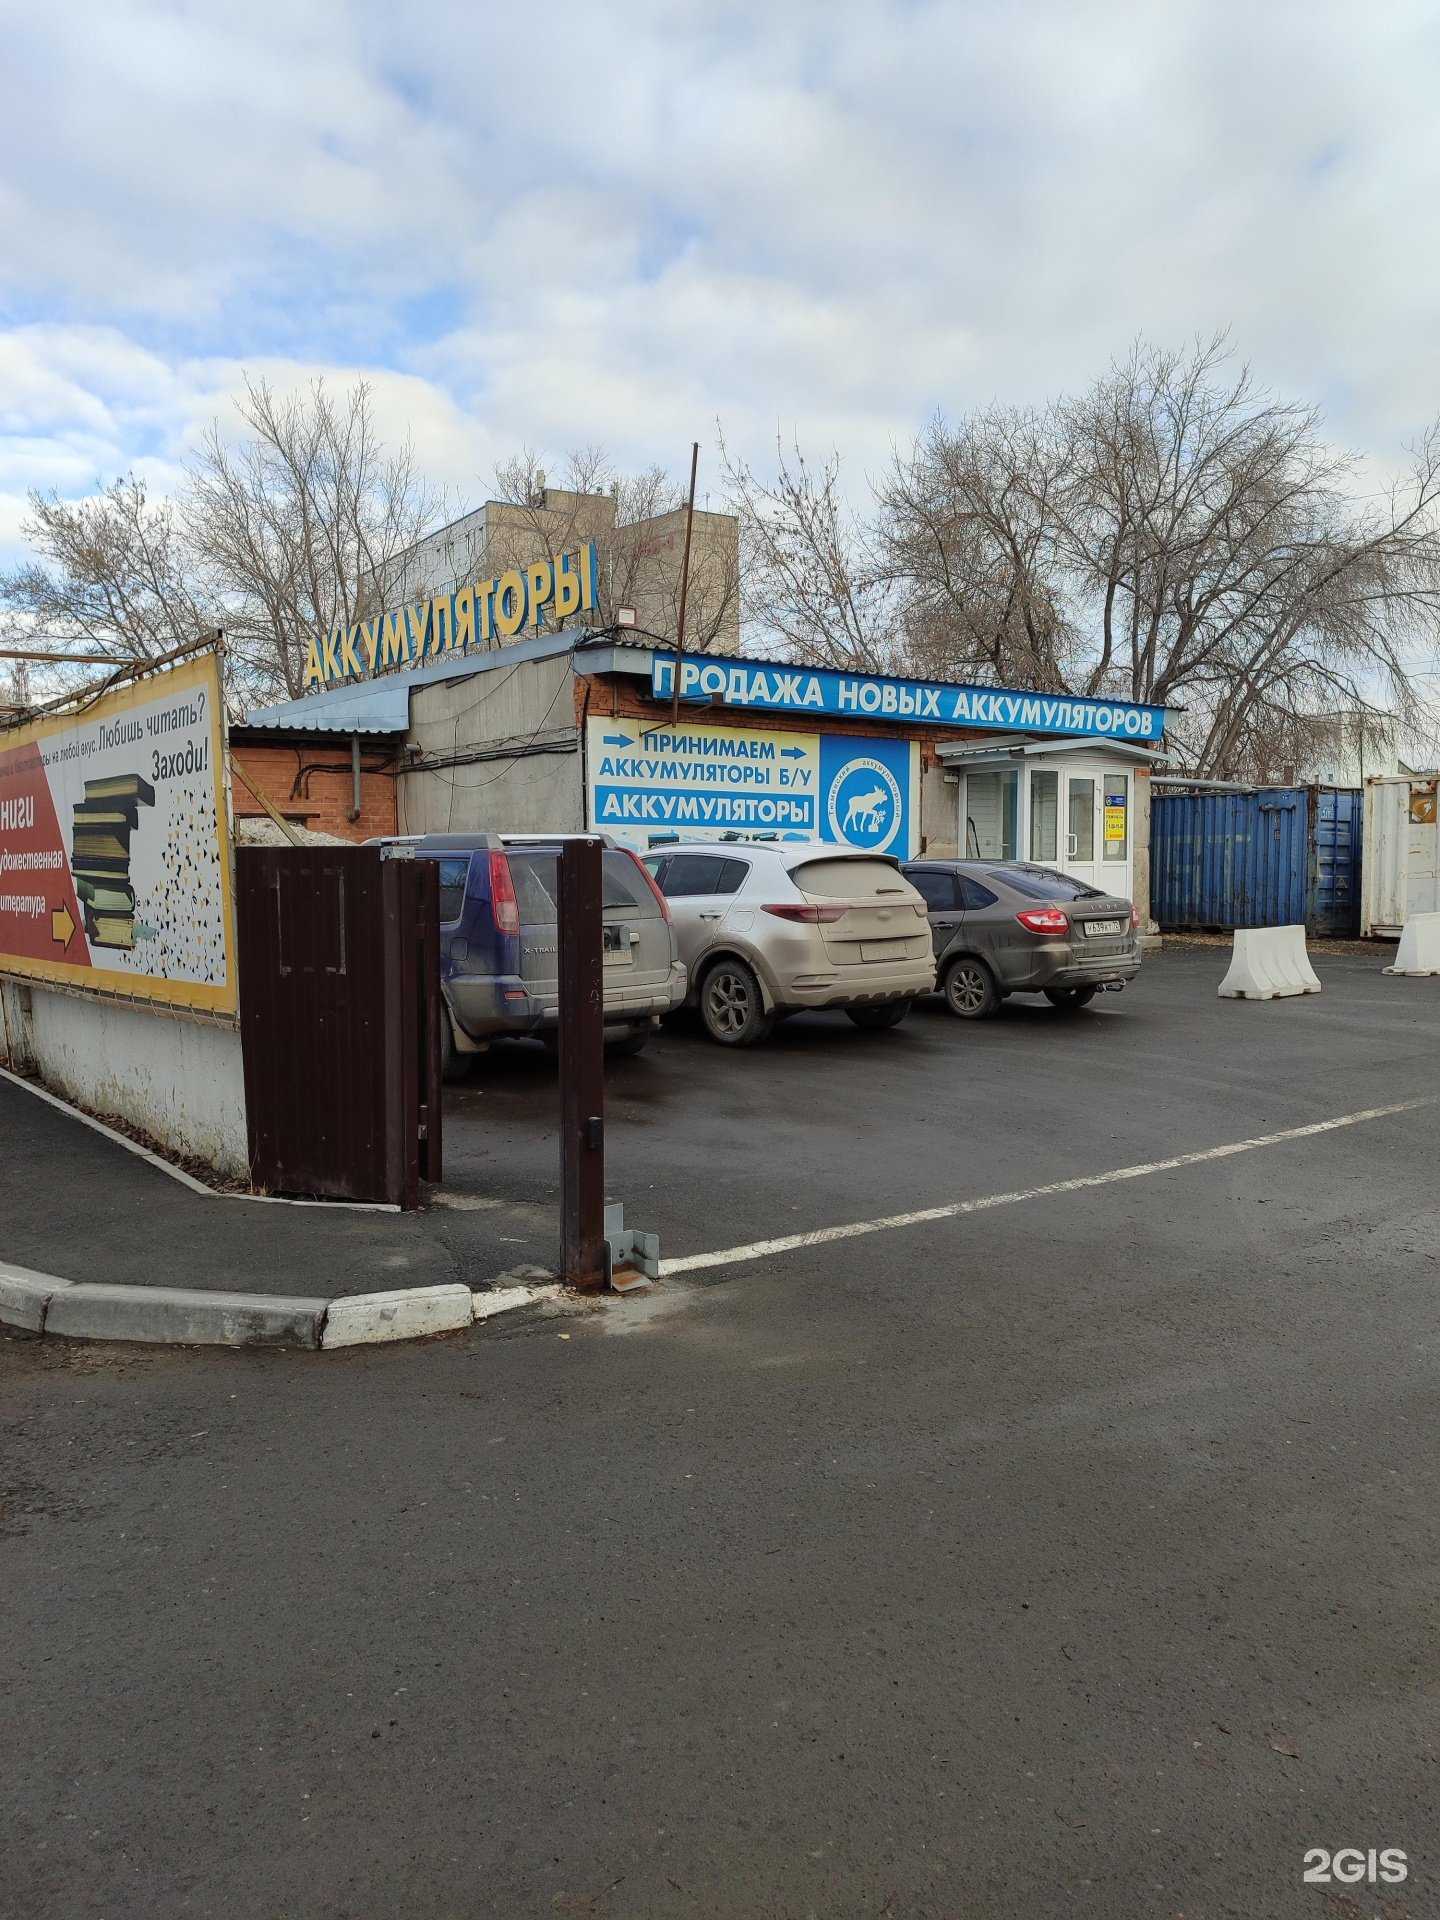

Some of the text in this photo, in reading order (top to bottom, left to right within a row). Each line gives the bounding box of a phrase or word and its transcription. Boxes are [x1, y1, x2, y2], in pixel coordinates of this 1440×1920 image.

[304, 541, 600, 686] АККУМУЛЯТОРЫ
[654, 659, 1153, 735] ПРОДАЖА НОВЫХ АККУМУЛЯТОРОВ
[99, 718, 143, 752] Любишь
[146, 692, 206, 736] читать?
[151, 736, 208, 782] Заходи!
[643, 733, 775, 760] ПРИНИМАЕМ
[599, 757, 812, 788] АККУМУЛЯТОРЫ Б/У
[601, 793, 809, 823] АККУМУЛЯТОРЫ
